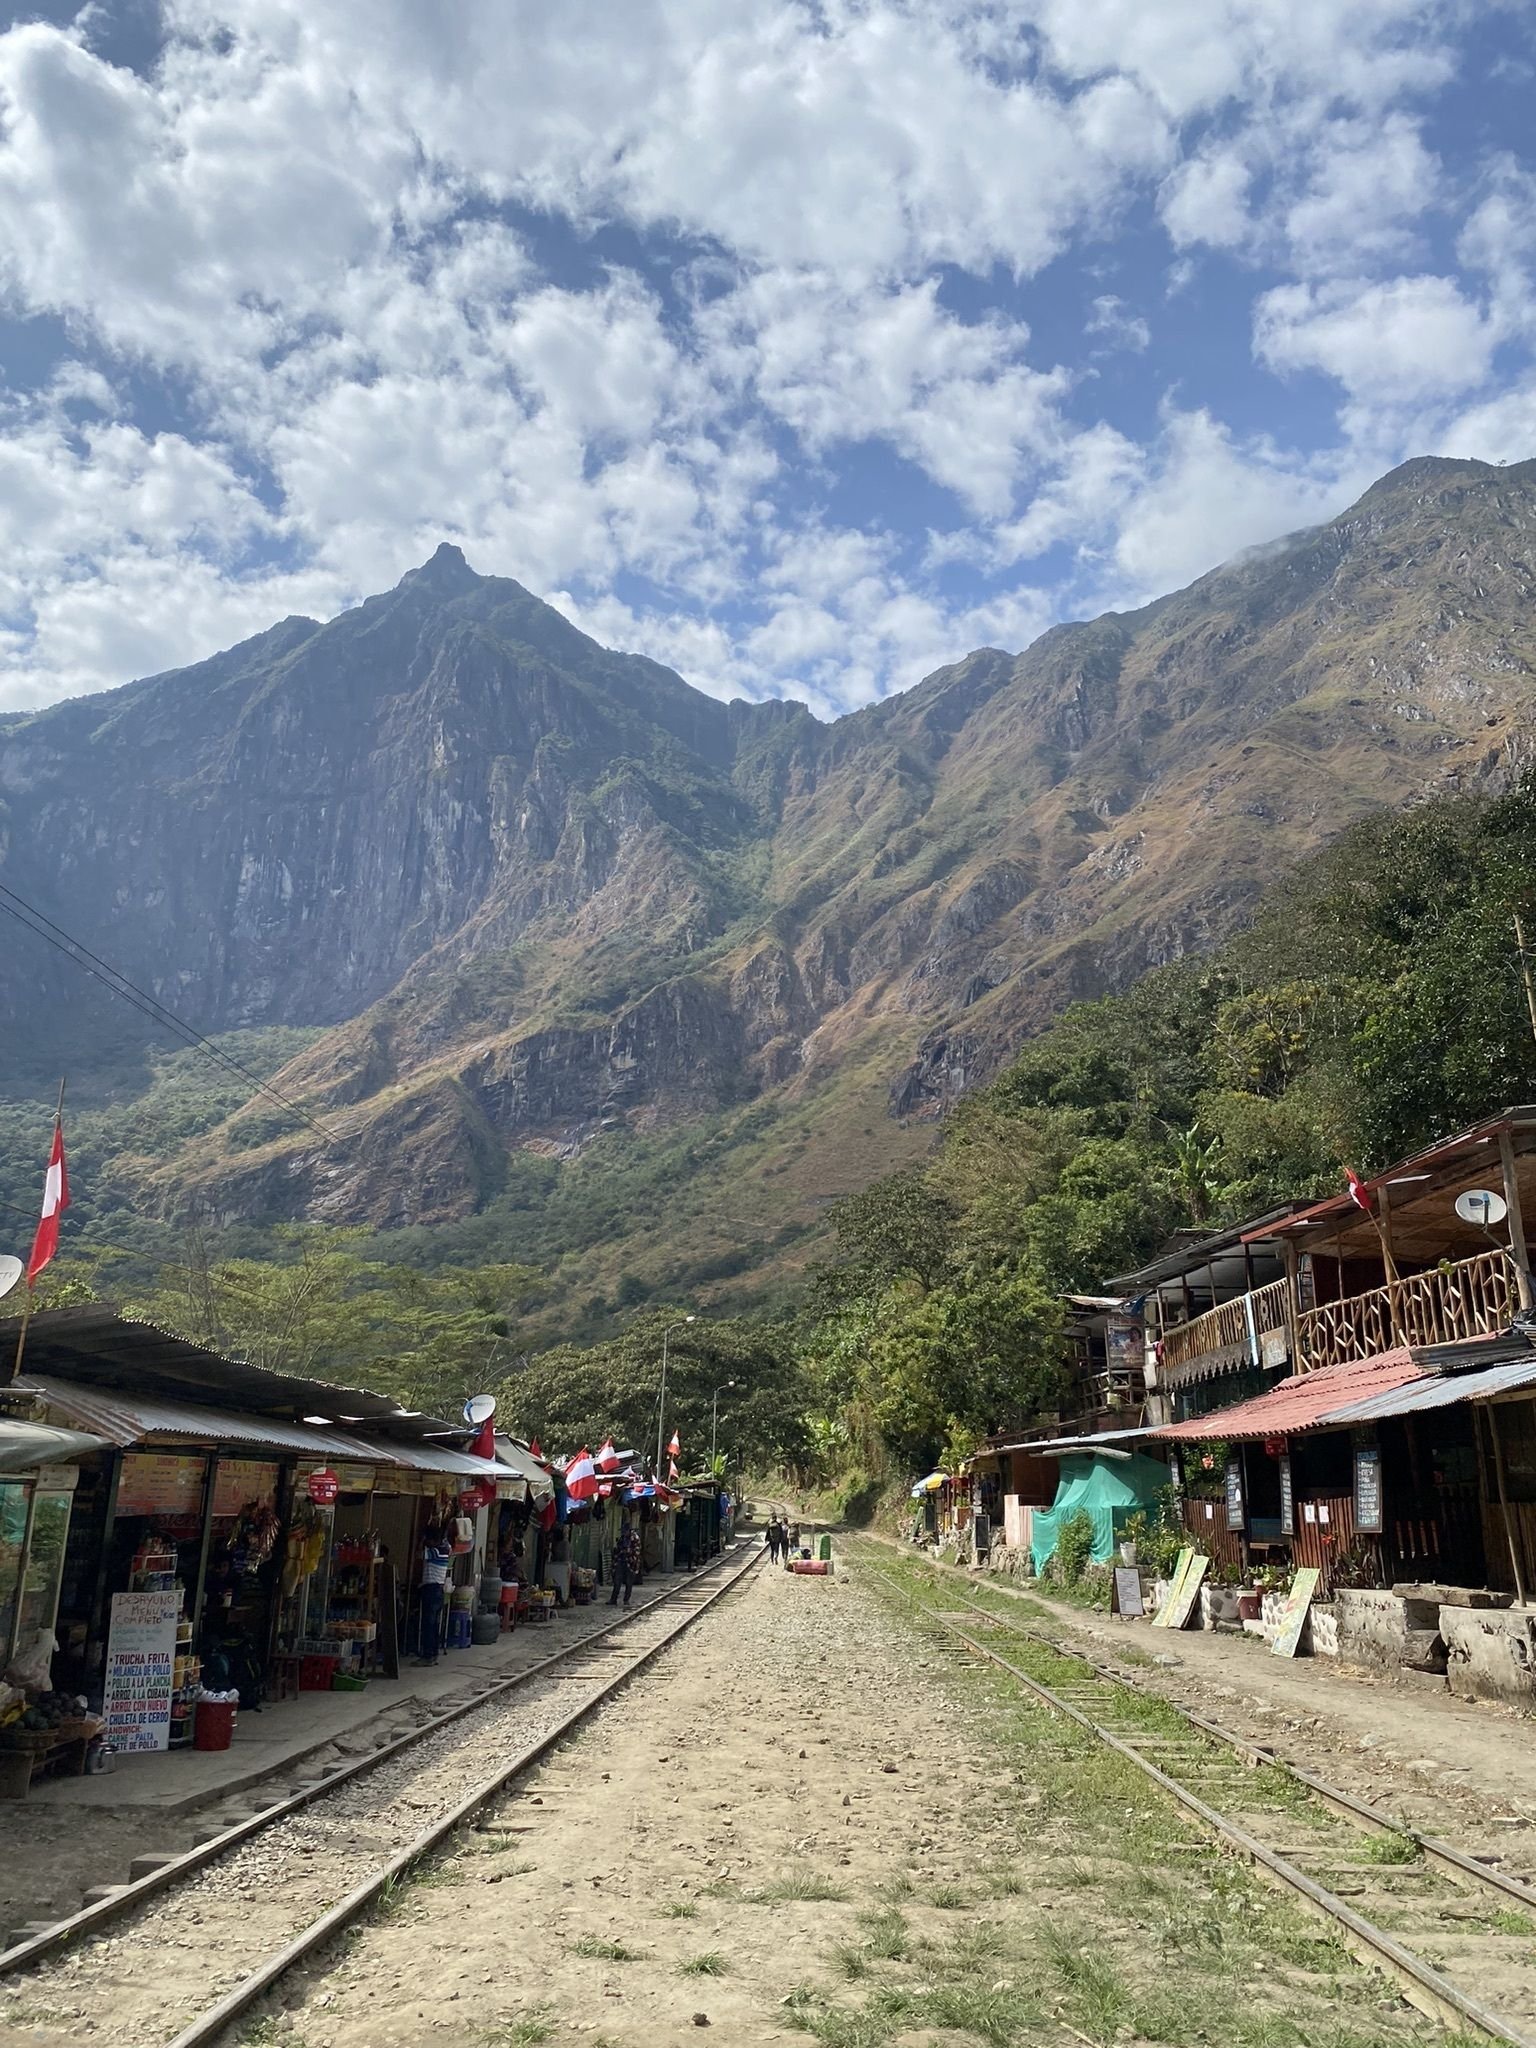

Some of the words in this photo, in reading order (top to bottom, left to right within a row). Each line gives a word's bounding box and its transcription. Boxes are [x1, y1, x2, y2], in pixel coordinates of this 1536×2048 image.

[118, 1595, 175, 1606] DESAYUNO
[131, 1605, 159, 1615] MENU
[115, 1654, 145, 1665] TRUCHA
[147, 1653, 170, 1664] FRITA
[113, 1665, 142, 1676] MILANEZA
[143, 1665, 151, 1675] DE
[152, 1664, 170, 1675] POLLO
[111, 1677, 130, 1689] POLLO
[131, 1677, 136, 1688] A
[137, 1677, 145, 1688] LA
[145, 1676, 171, 1687] PLANCHA
[111, 1689, 131, 1700] ARROZ
[132, 1689, 136, 1700] A
[137, 1689, 145, 1700] LA
[146, 1688, 169, 1698] CUBANA
[110, 1701, 131, 1713] ARROZ
[133, 1700, 146, 1711] CON
[147, 1700, 168, 1711] HUEVO
[109, 1713, 137, 1725] CHULETA
[138, 1713, 146, 1724] DE
[148, 1712, 169, 1723] CERDO
[108, 1734, 128, 1742] CARNE
[135, 1732, 154, 1741] PALTA
[129, 1741, 137, 1750] DE
[138, 1740, 158, 1749] POLLO
